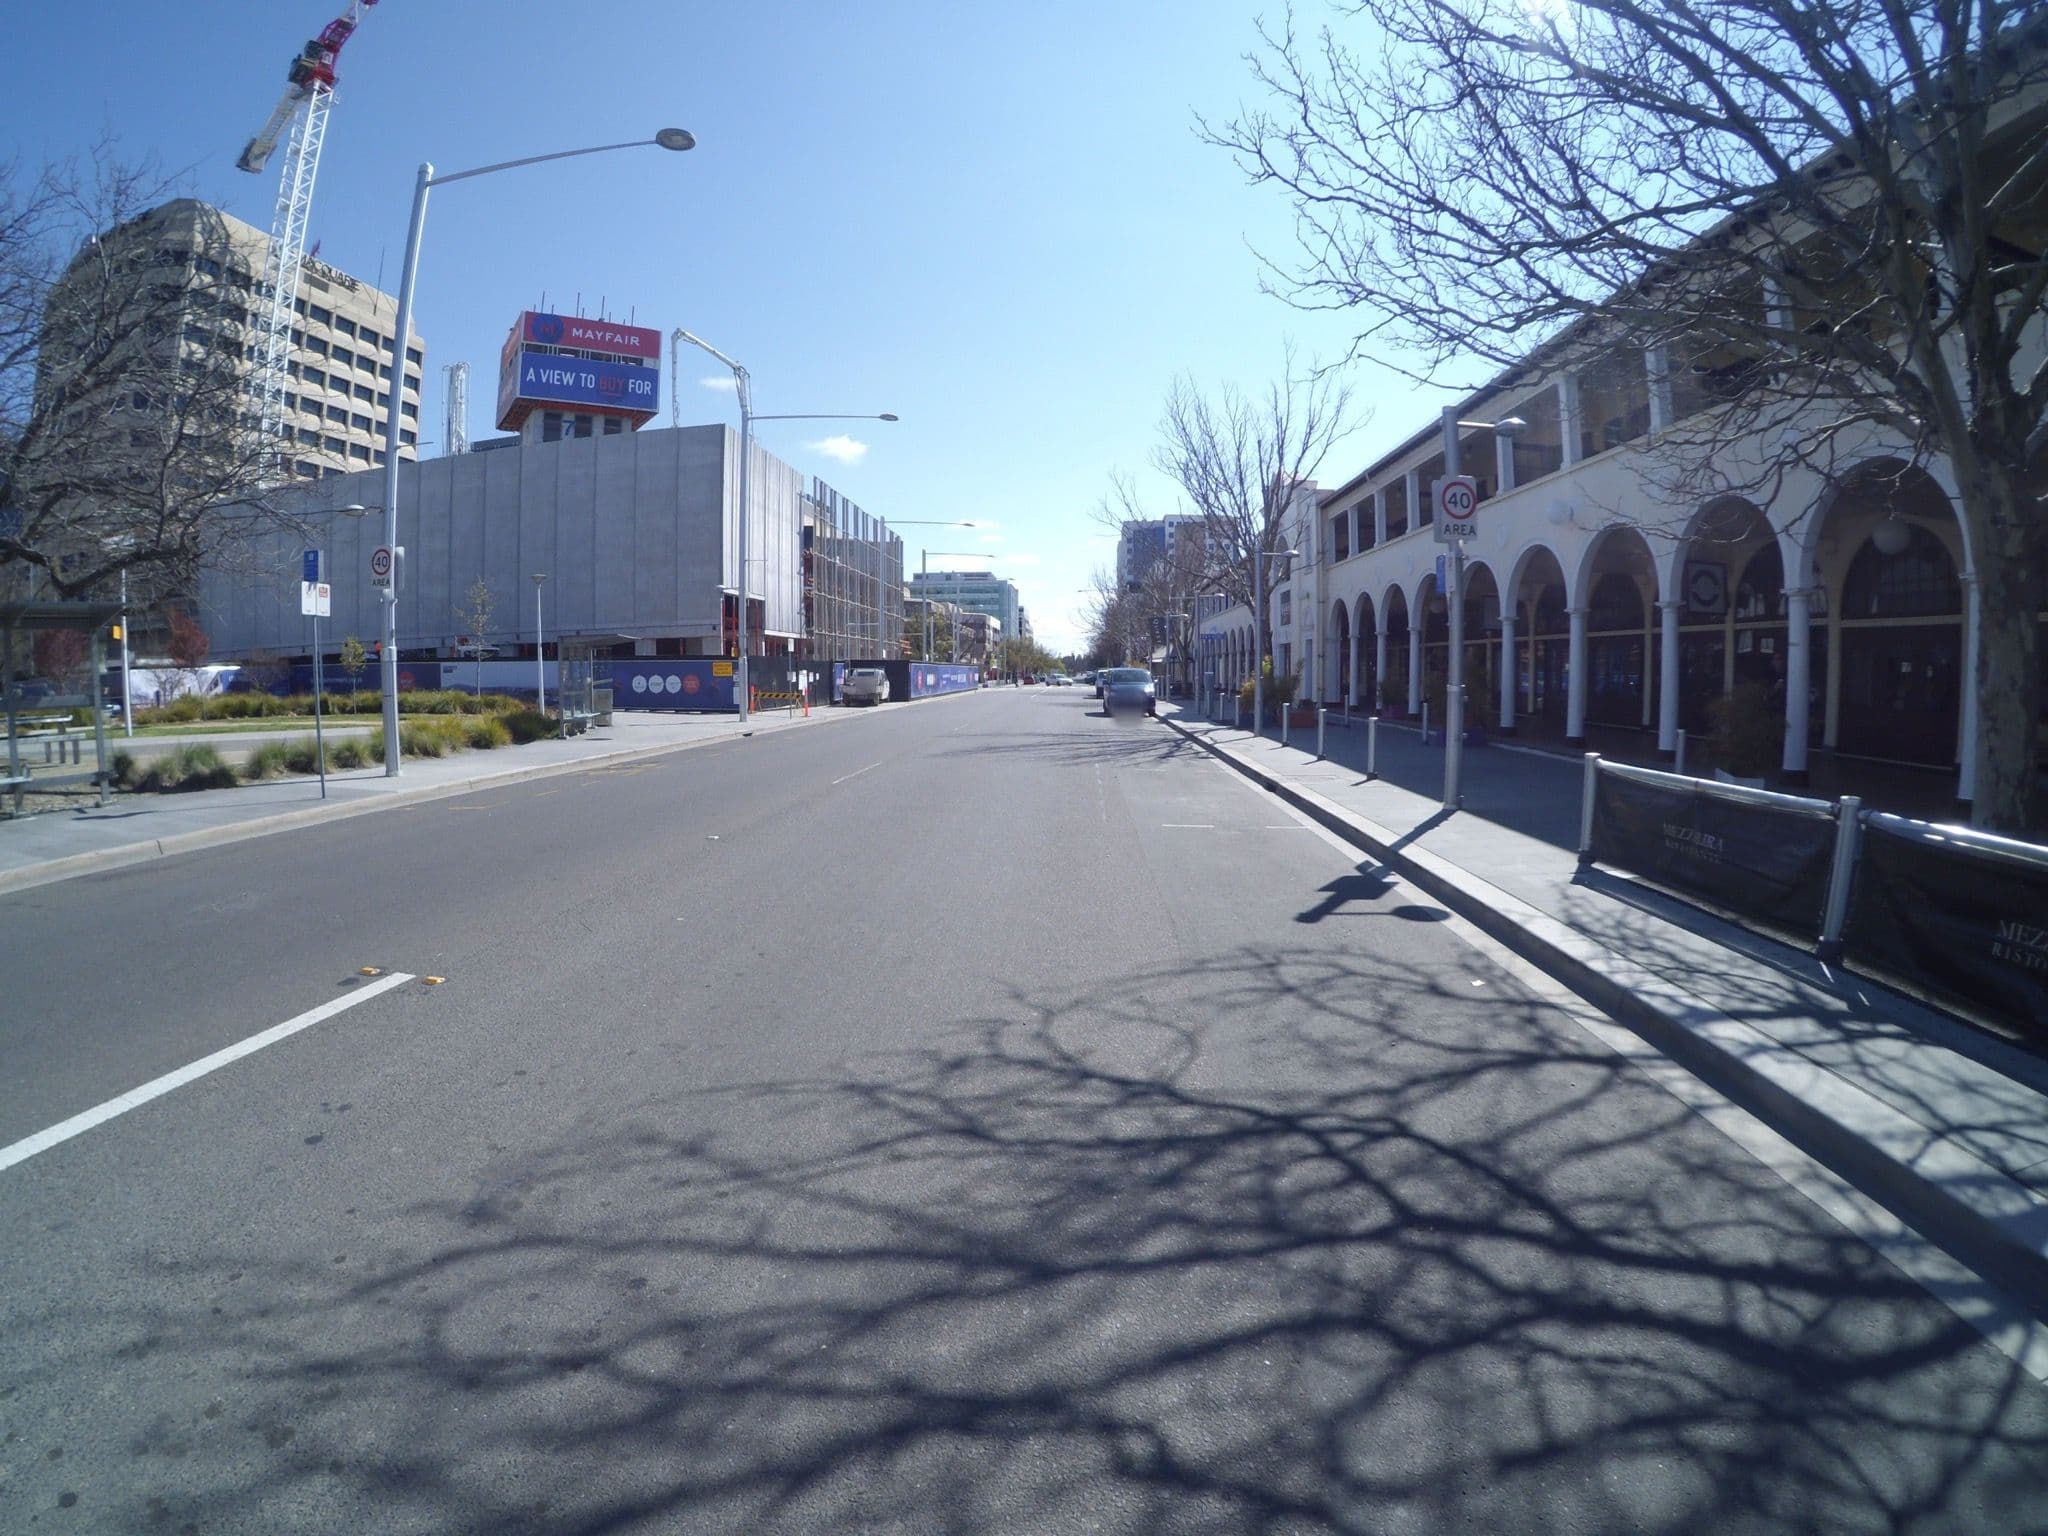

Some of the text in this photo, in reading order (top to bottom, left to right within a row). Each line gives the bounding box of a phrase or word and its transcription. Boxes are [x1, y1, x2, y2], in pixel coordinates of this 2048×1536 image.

[572, 327, 640, 346] MAYFAIR
[526, 367, 537, 383] A
[540, 368, 576, 387] VIEW
[580, 373, 596, 389] TO
[628, 379, 652, 396] FOR
[1448, 492, 1471, 509] 40
[1444, 524, 1476, 536] AREA
[375, 556, 388, 568] 40
[372, 578, 390, 587] AREA
